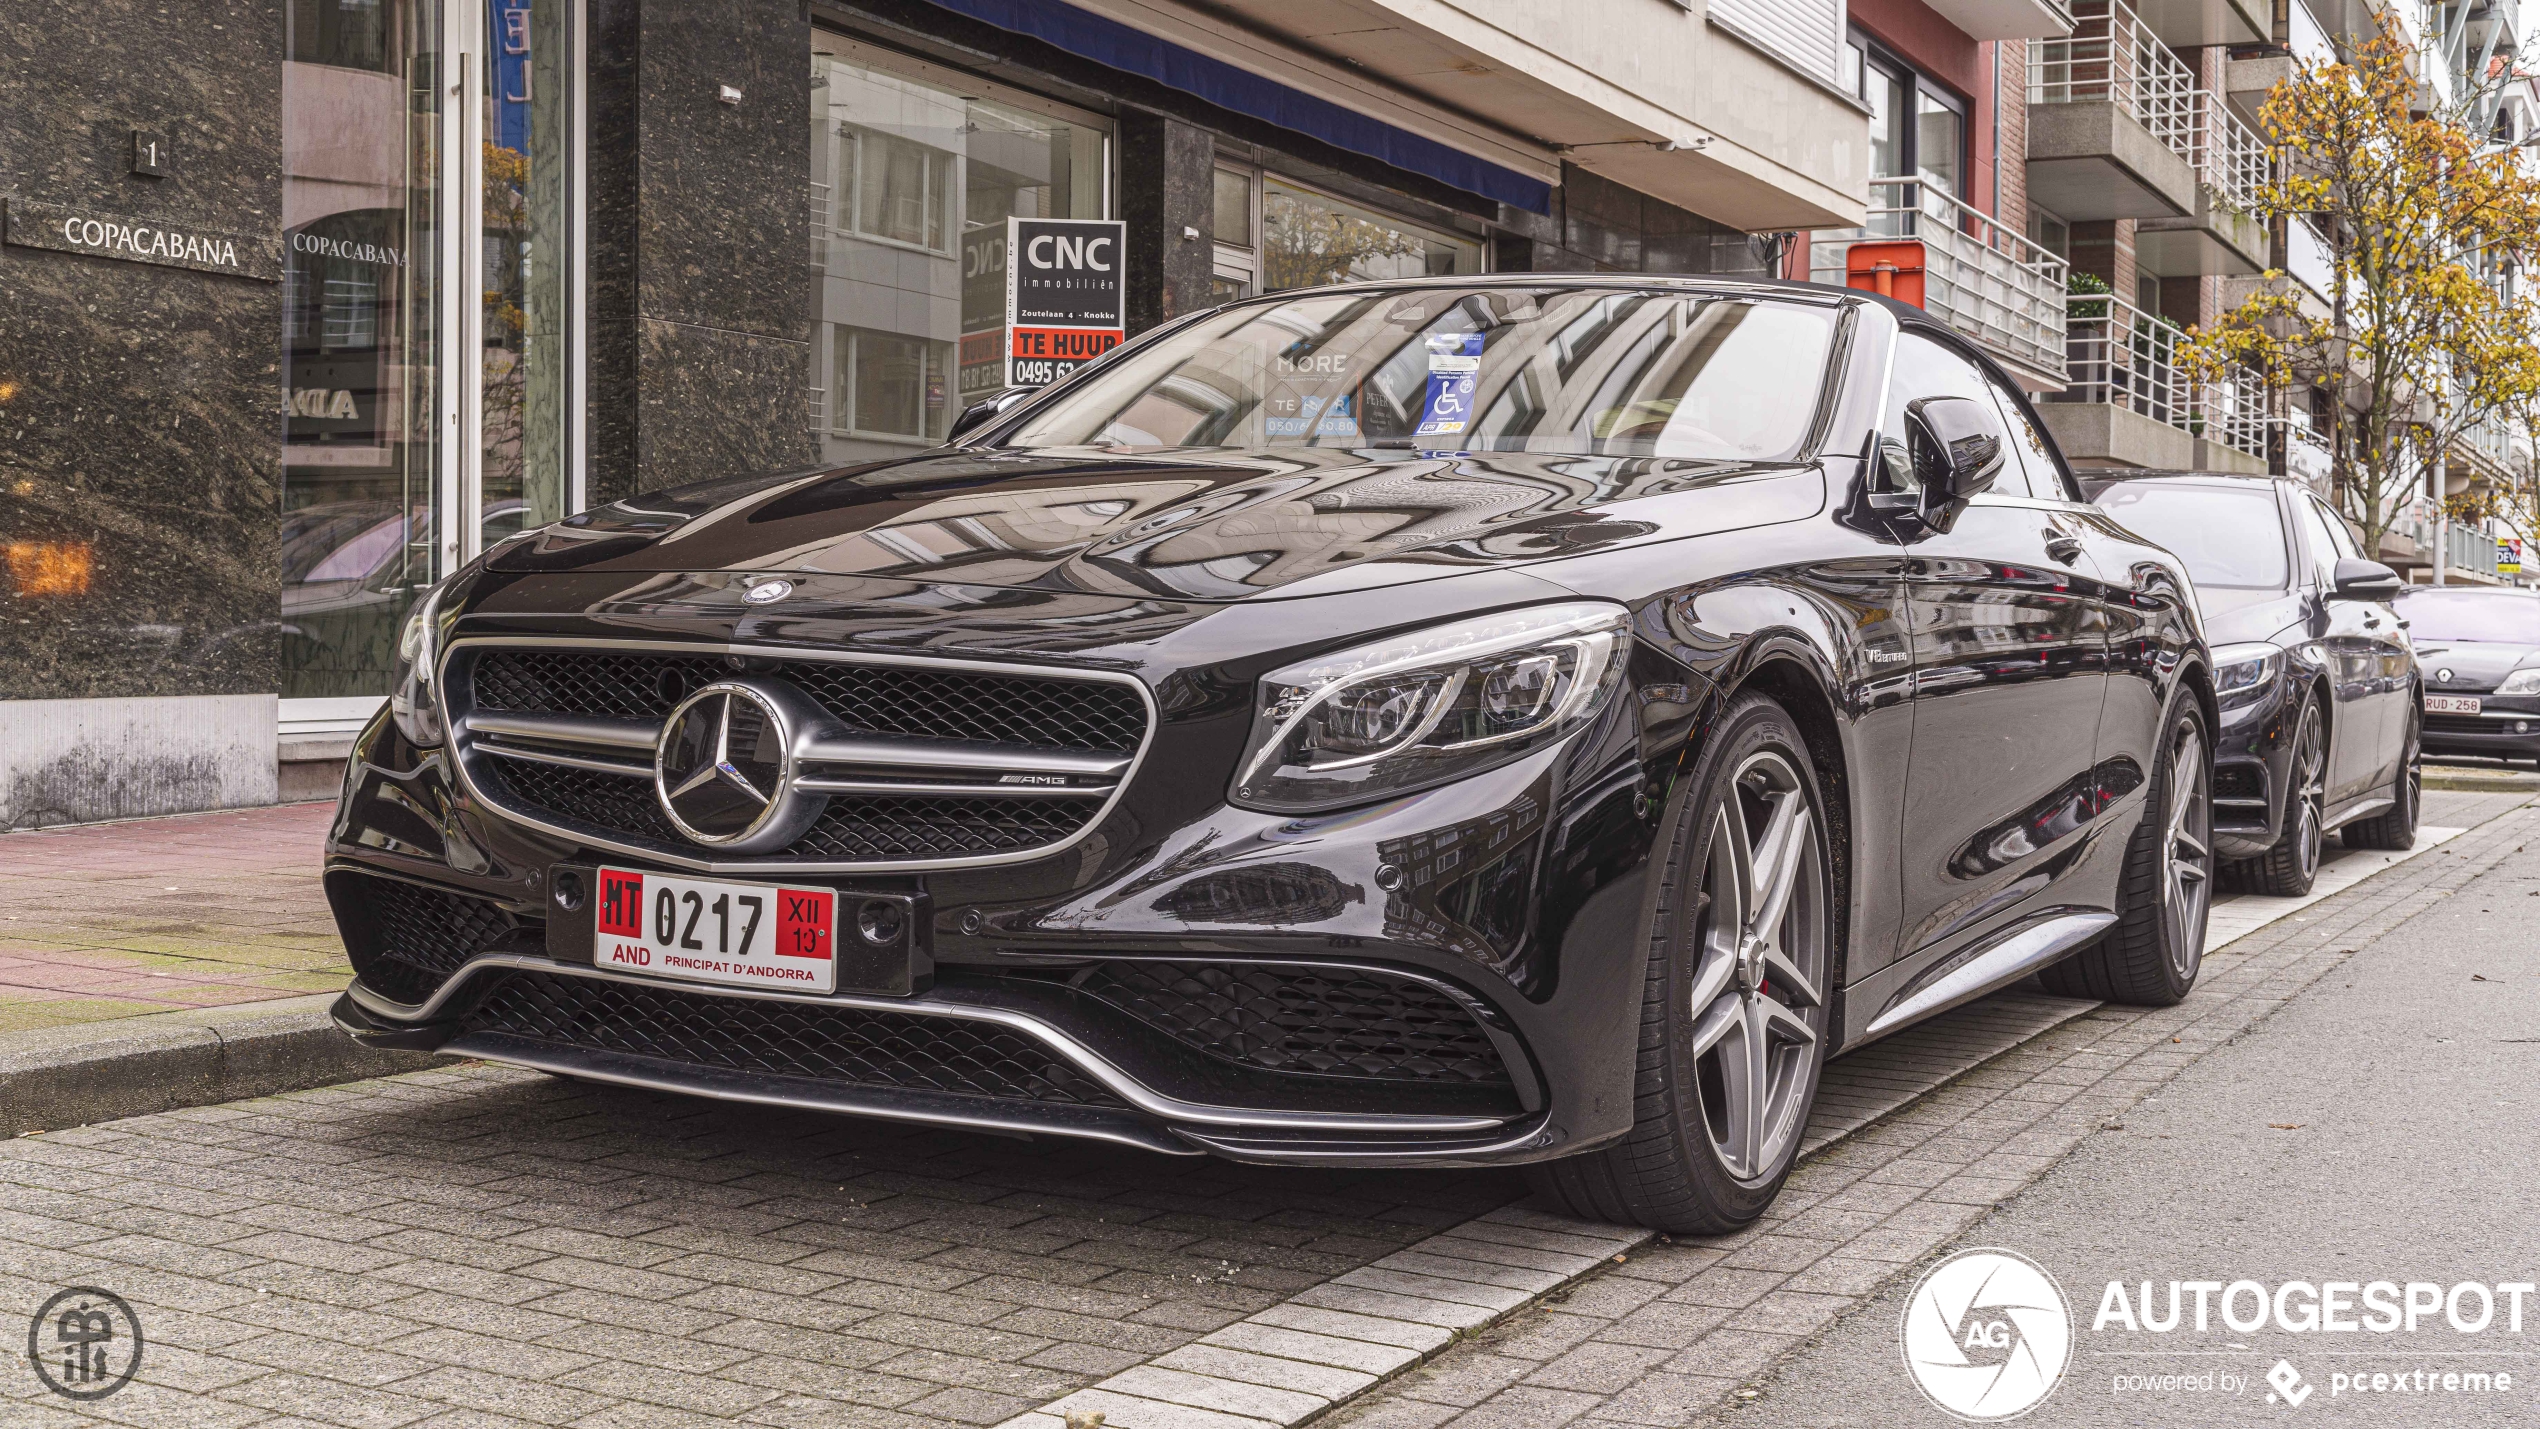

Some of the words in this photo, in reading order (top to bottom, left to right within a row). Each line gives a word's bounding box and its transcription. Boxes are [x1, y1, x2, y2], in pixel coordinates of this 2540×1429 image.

[148, 140, 157, 167] 1
[64, 217, 238, 267] COPACABANA
[293, 233, 411, 268] COPACABANA
[1027, 235, 1112, 272] CNC
[1024, 276, 1114, 290] immobiliën
[1021, 309, 1064, 318] Zoutelaan
[1084, 311, 1115, 320] Knokke
[1019, 333, 1046, 355] TE
[1016, 361, 1053, 384] 0495
[1277, 354, 1347, 373] MORE
[1275, 400, 1295, 411] TE
[1020, 776, 1065, 785] AMG
[605, 878, 641, 928] MT
[655, 886, 763, 956] 0217
[787, 896, 819, 924] XII
[612, 943, 650, 966] AND
[665, 955, 730, 974] PRINCIPAT
[733, 963, 815, 982] D'ANDORRA
